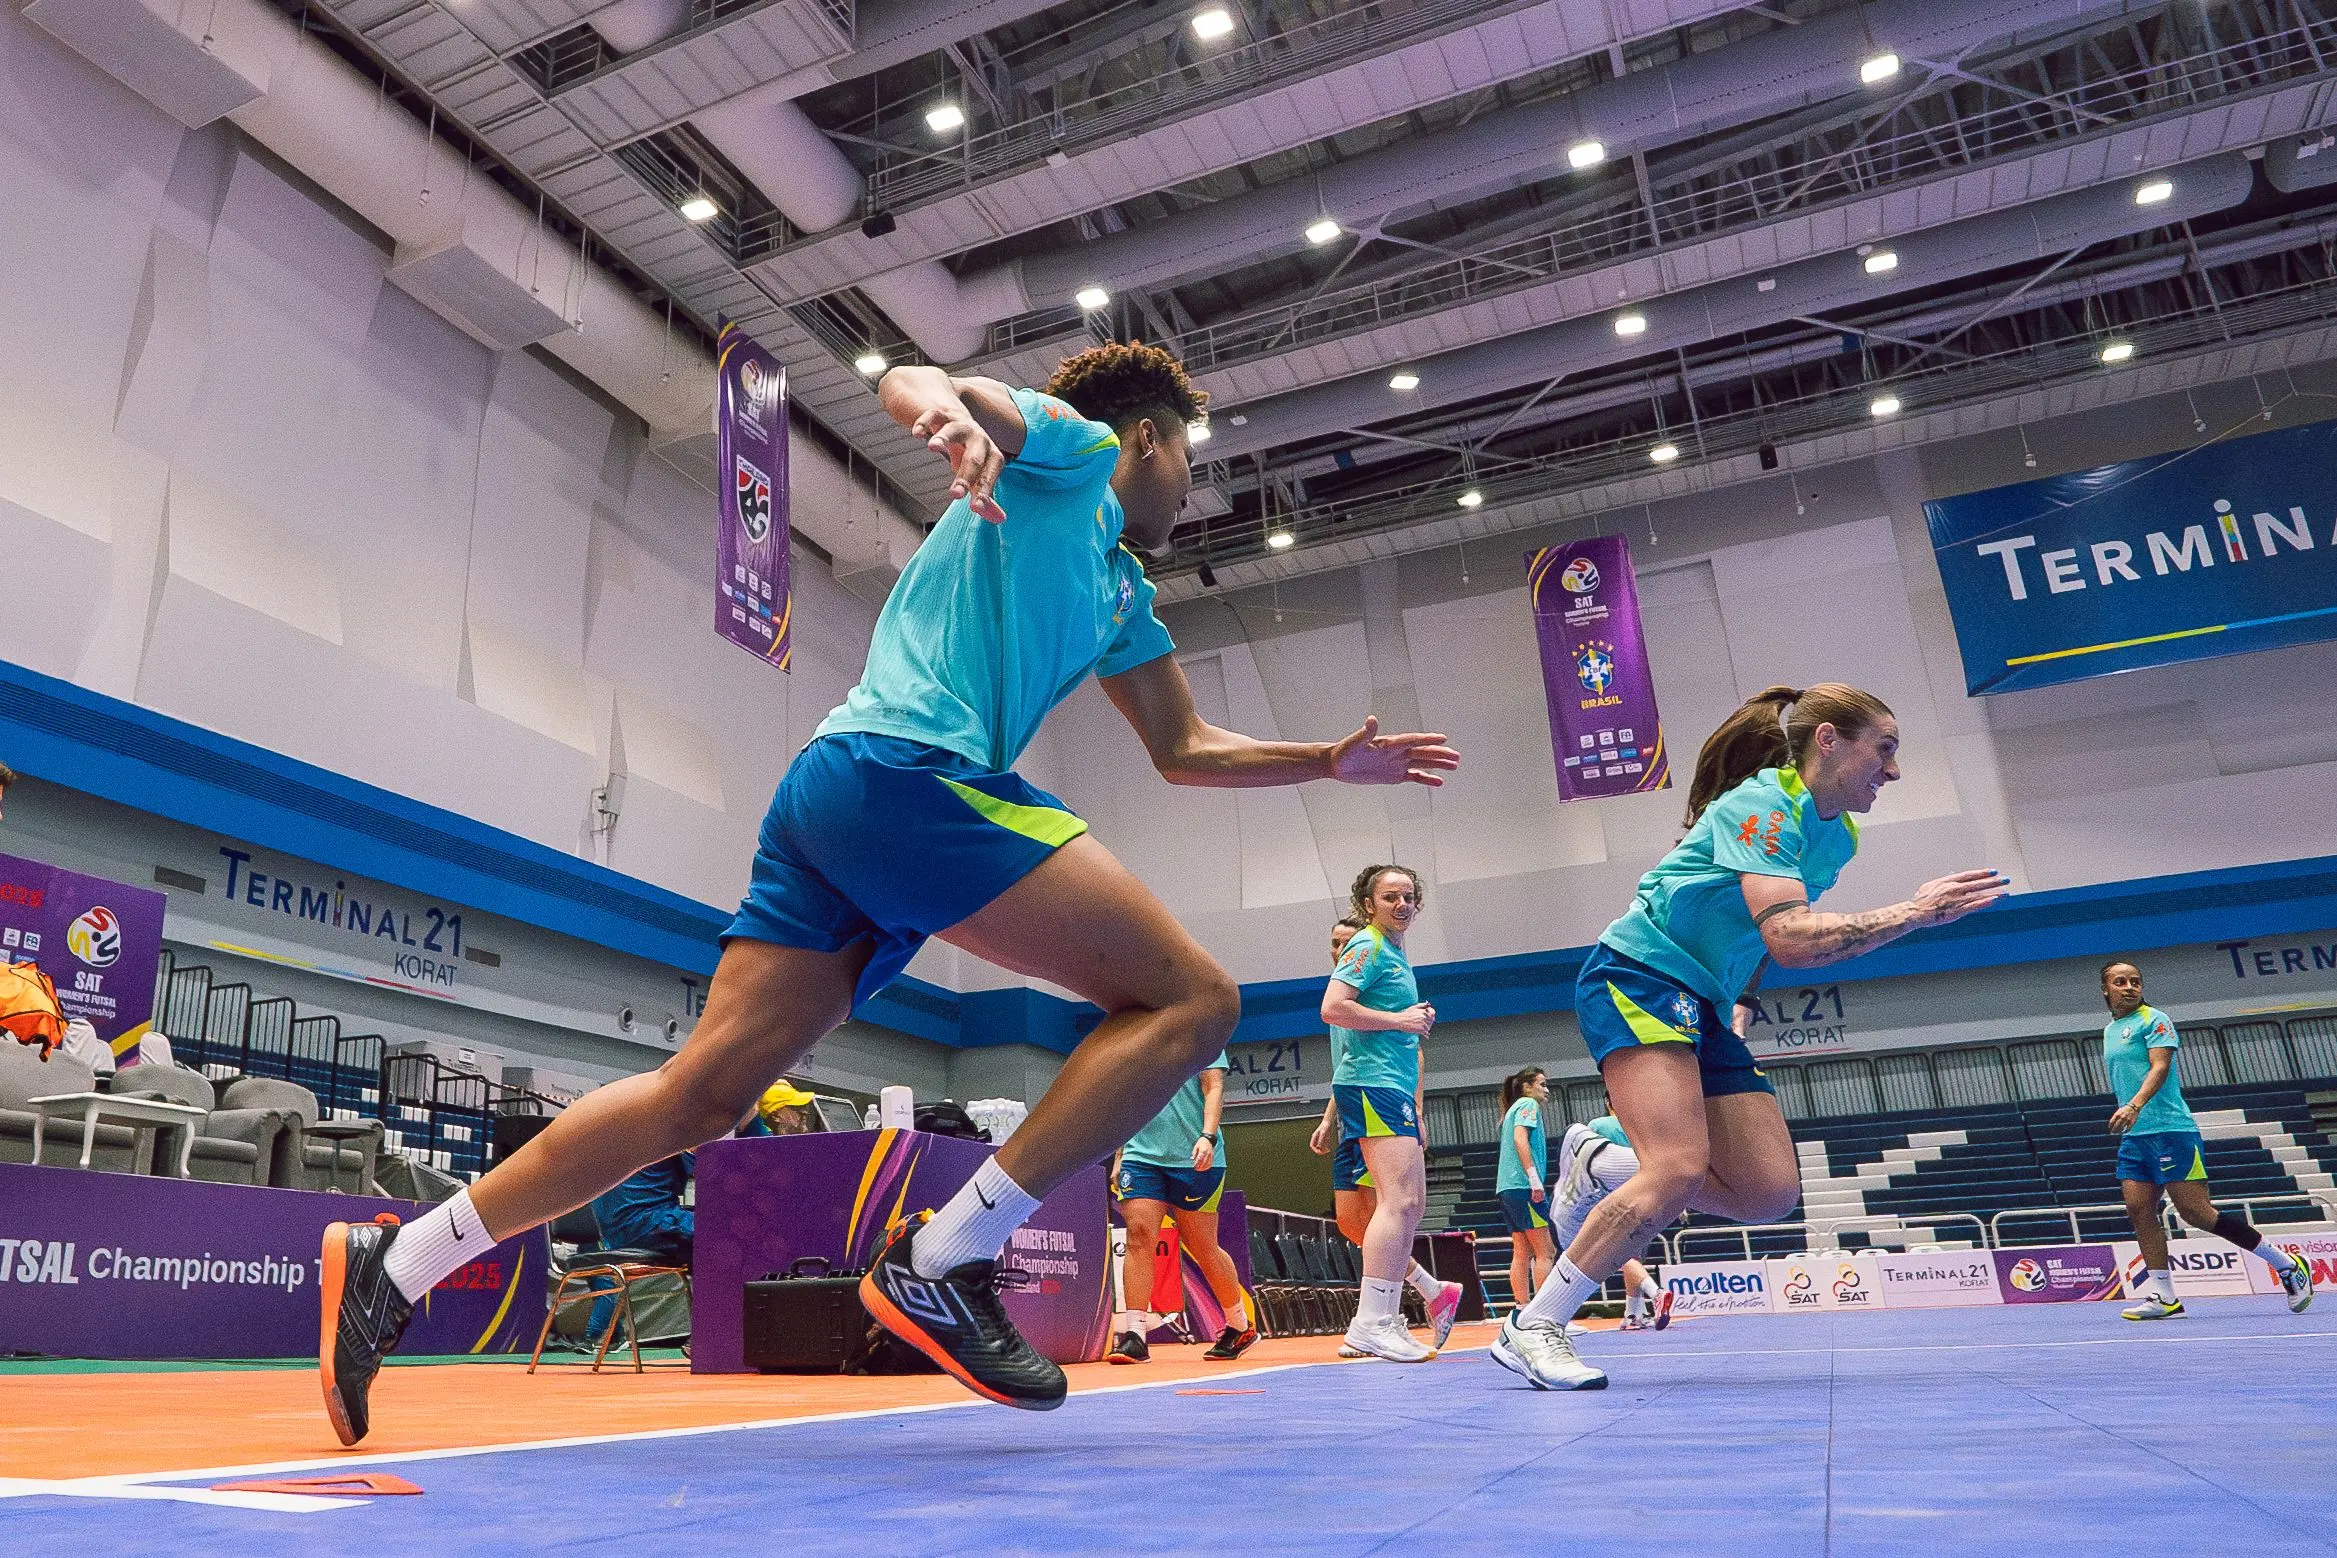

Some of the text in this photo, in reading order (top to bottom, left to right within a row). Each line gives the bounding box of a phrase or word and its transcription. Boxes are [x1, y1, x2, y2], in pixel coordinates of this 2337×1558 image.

[1580, 695, 1623, 710] BRASIL
[394, 951, 458, 987] KORAT
[74, 970, 104, 993] SAT
[60, 1000, 116, 1020] hampionship
[1775, 1024, 1848, 1048] KORAT
[88, 1247, 305, 1293] Championship
[1011, 1253, 1079, 1280] Championship
[2168, 1252, 2240, 1272] NSDF
[1668, 1271, 1764, 1296] molten
[1788, 1291, 1821, 1305] SAT
[1839, 1289, 1870, 1303] SAT
